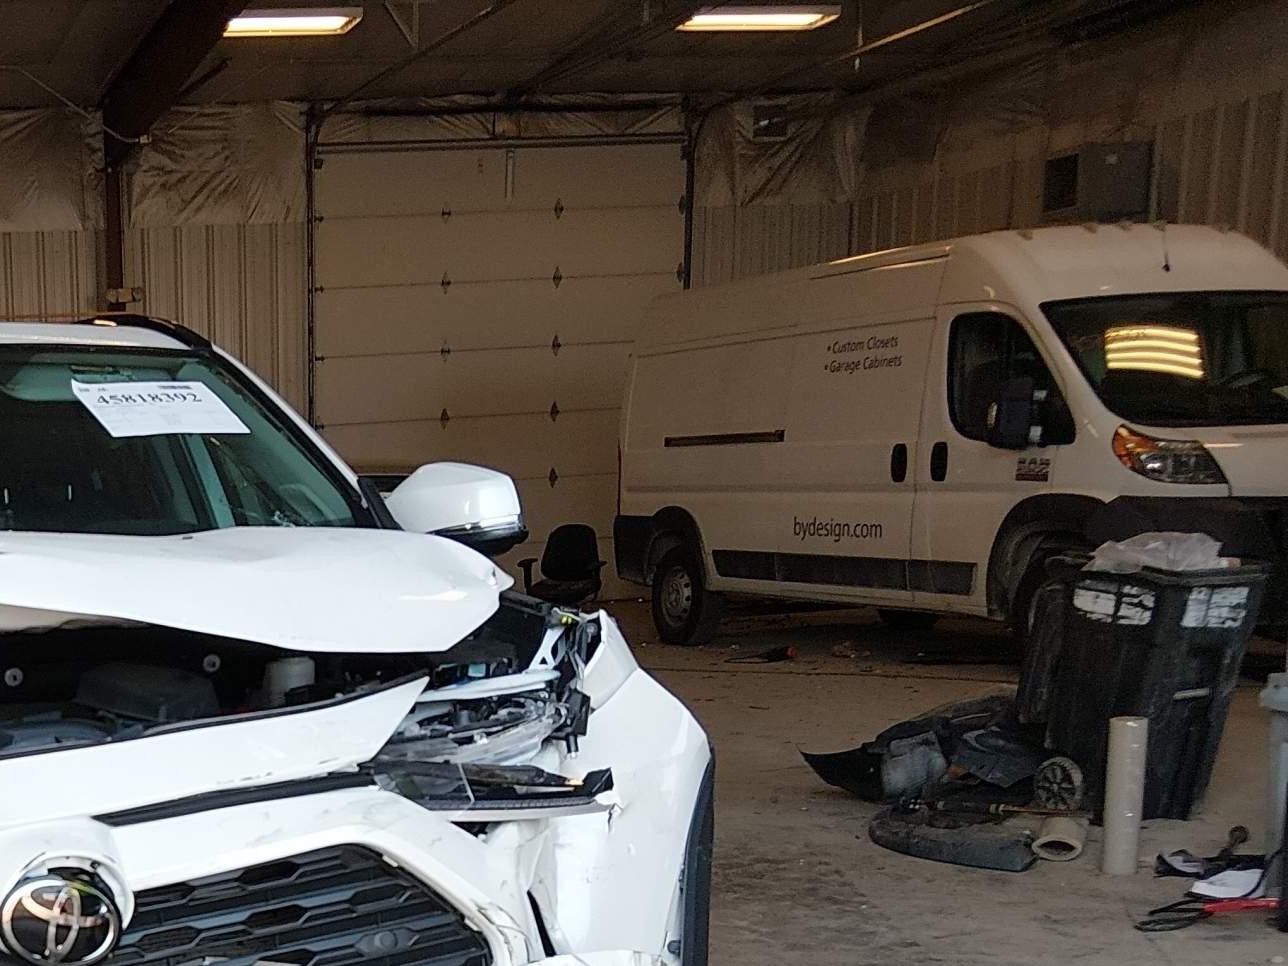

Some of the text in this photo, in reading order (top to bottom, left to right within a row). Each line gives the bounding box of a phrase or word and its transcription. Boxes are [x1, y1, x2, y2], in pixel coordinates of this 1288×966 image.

[832, 336, 899, 354] Custom Closets
[829, 356, 903, 374] Garage Cabinets
[97, 392, 202, 405] 45818392
[793, 516, 883, 542] bydesign.com
